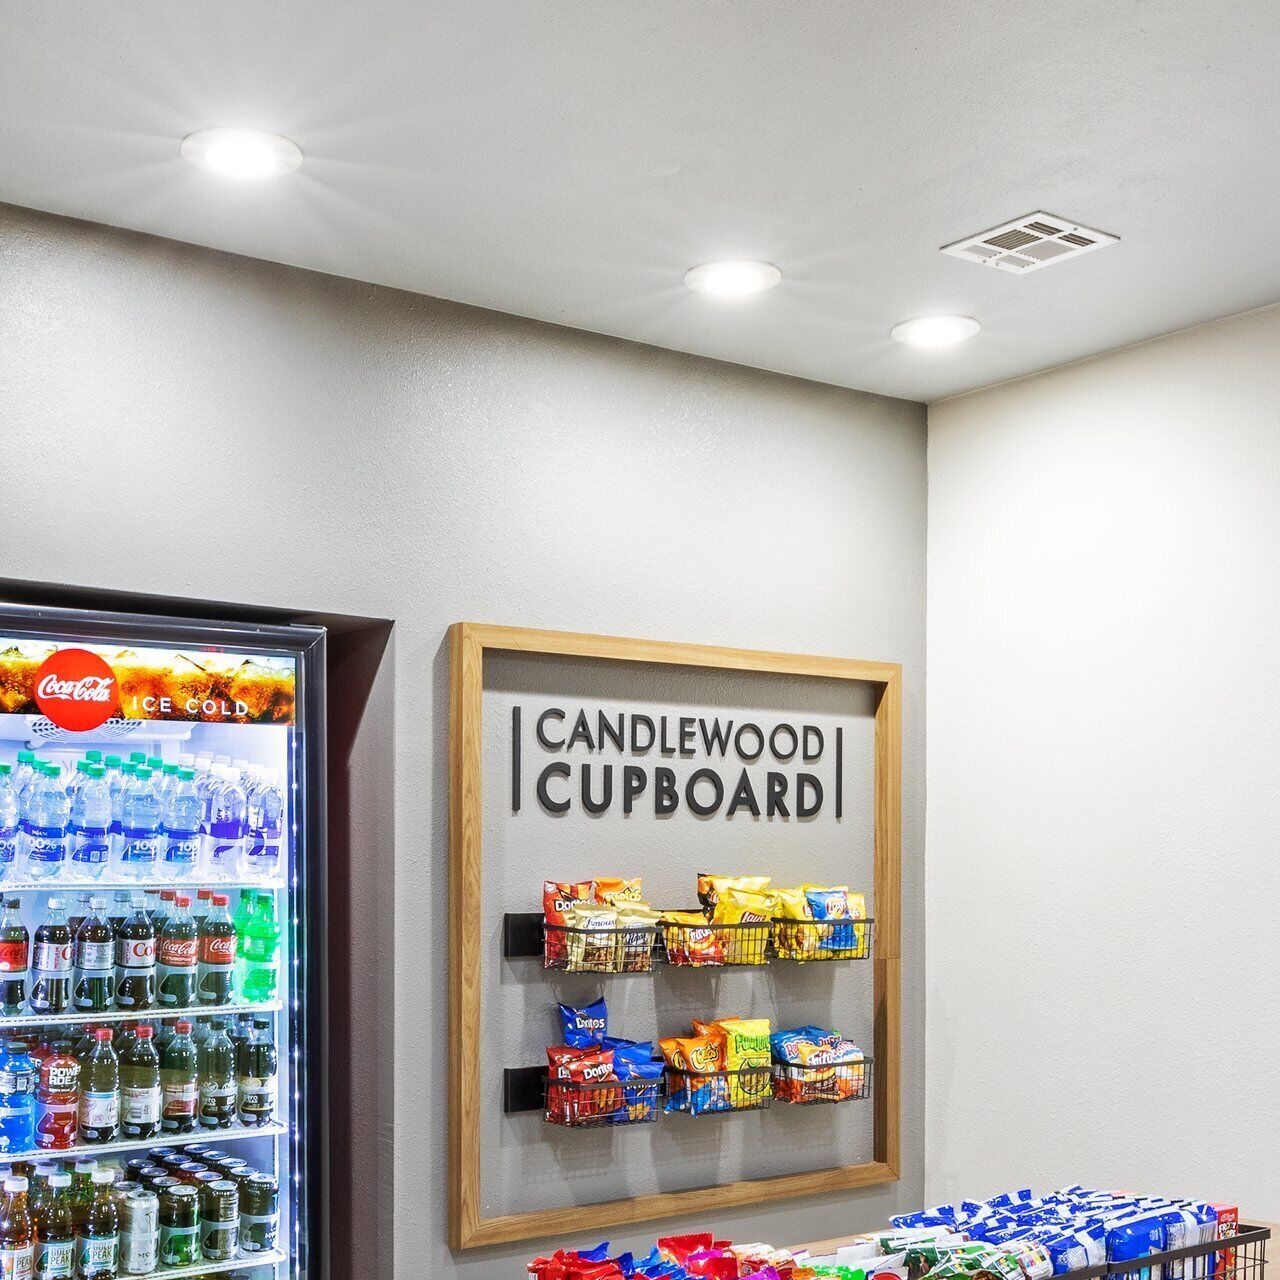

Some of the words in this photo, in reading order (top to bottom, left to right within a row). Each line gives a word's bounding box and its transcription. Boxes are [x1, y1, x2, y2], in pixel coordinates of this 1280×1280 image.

[38, 674, 115, 702] Coca-Cola
[132, 696, 172, 712] ICE
[186, 699, 249, 716] COLD
[536, 708, 824, 760] CANDLEWOOD
[536, 761, 824, 818] CUPBOARD
[575, 1018, 605, 1029] Doritos
[583, 1064, 613, 1079] Dorito
[50, 1255, 70, 1265] PEAK
[92, 1249, 111, 1259] PEAK
